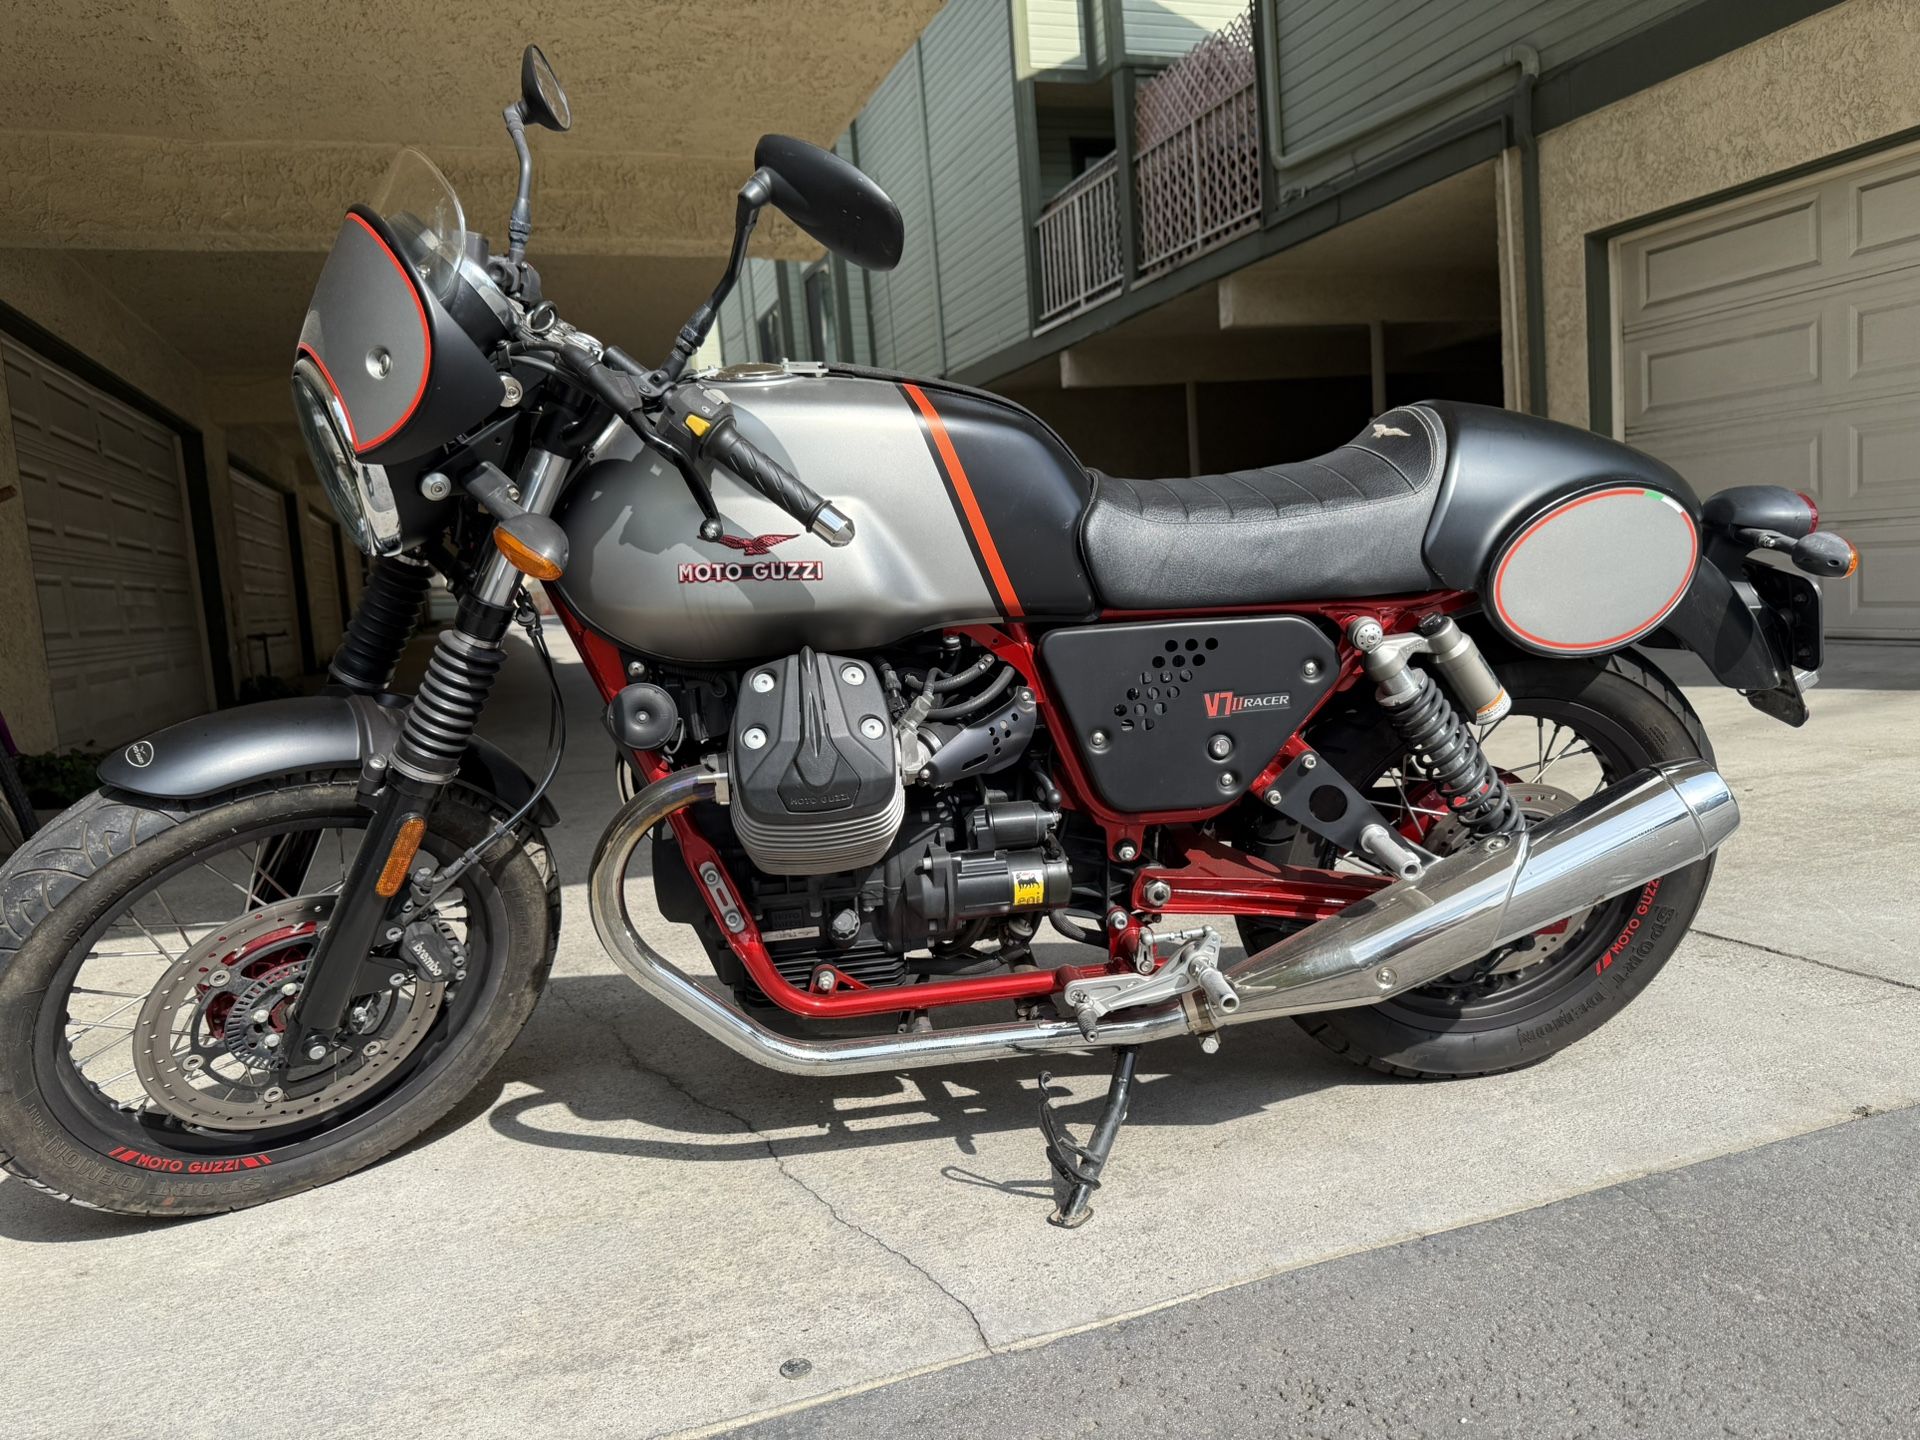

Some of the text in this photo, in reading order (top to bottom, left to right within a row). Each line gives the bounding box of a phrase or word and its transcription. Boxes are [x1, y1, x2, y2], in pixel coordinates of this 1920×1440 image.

[678, 561, 823, 582] MOTO GUZZI
[1611, 918, 1640, 955] MOTO
[412, 941, 442, 976] brembo
[47, 1134, 141, 1193] DEMON
[136, 1153, 241, 1174] MOTO GUZZI
[150, 1173, 267, 1198] SPORT
